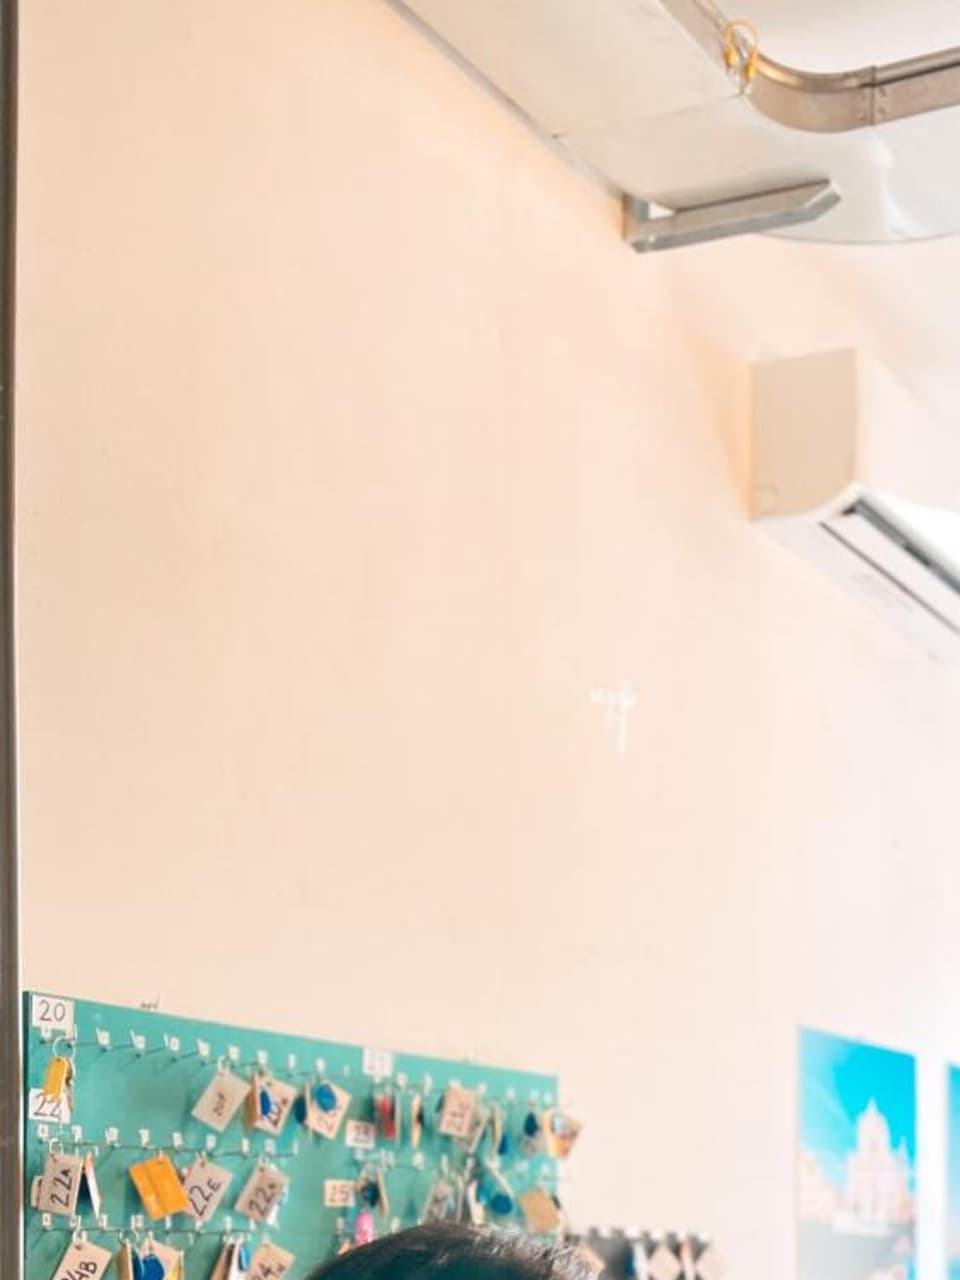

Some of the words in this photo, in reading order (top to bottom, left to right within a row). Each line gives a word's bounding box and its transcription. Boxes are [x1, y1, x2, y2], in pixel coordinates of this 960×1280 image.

[39, 999, 66, 1022] 20
[50, 1168, 74, 1208] 22A
[188, 1178, 222, 1217] 22E
